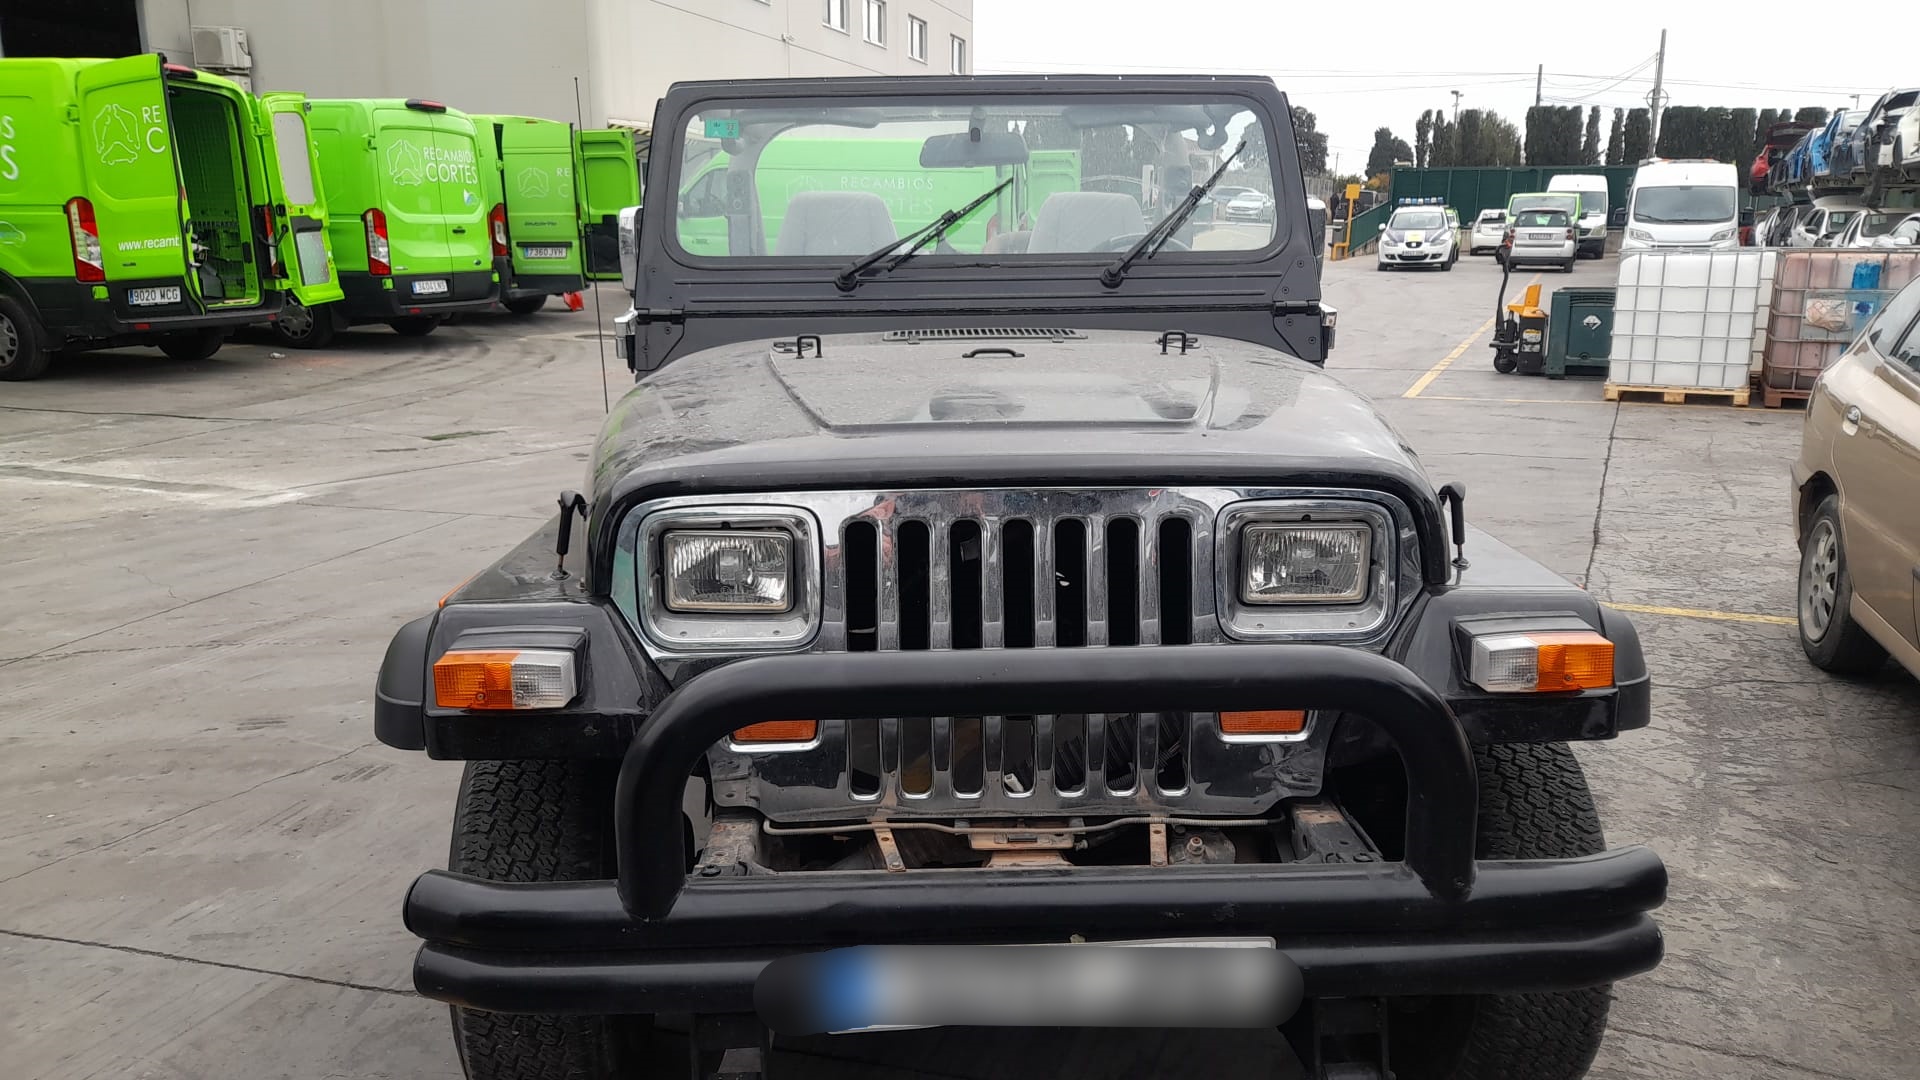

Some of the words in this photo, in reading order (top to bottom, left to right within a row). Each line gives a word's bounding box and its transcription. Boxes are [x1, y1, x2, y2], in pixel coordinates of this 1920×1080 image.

[426, 162, 478, 185] CORTES
[840, 176, 934, 190] RECAMBIOS
[134, 290, 156, 302] 9020
